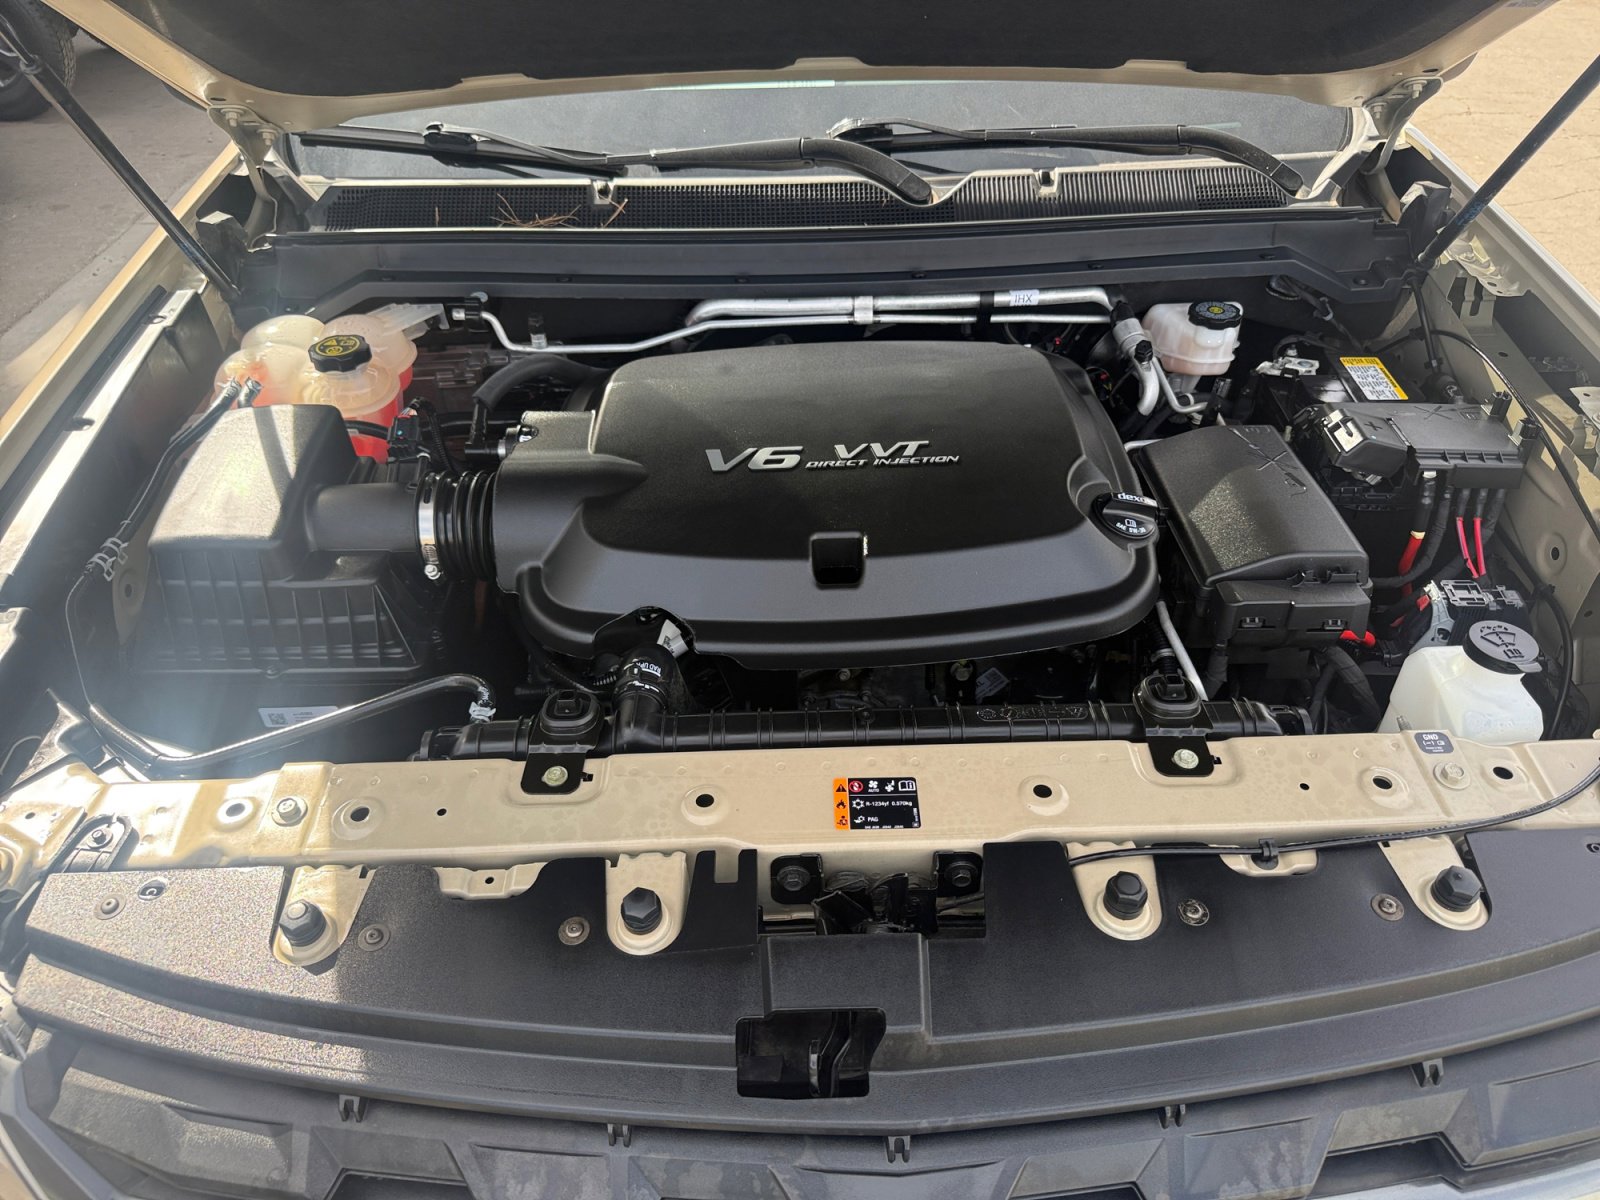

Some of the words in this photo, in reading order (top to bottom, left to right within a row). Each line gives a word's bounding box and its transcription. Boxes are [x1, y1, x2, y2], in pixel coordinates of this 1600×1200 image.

[705, 446, 803, 472] V6
[834, 441, 930, 460] VVT
[805, 459, 868, 469] DIRECT
[873, 455, 960, 467] INJECTION
